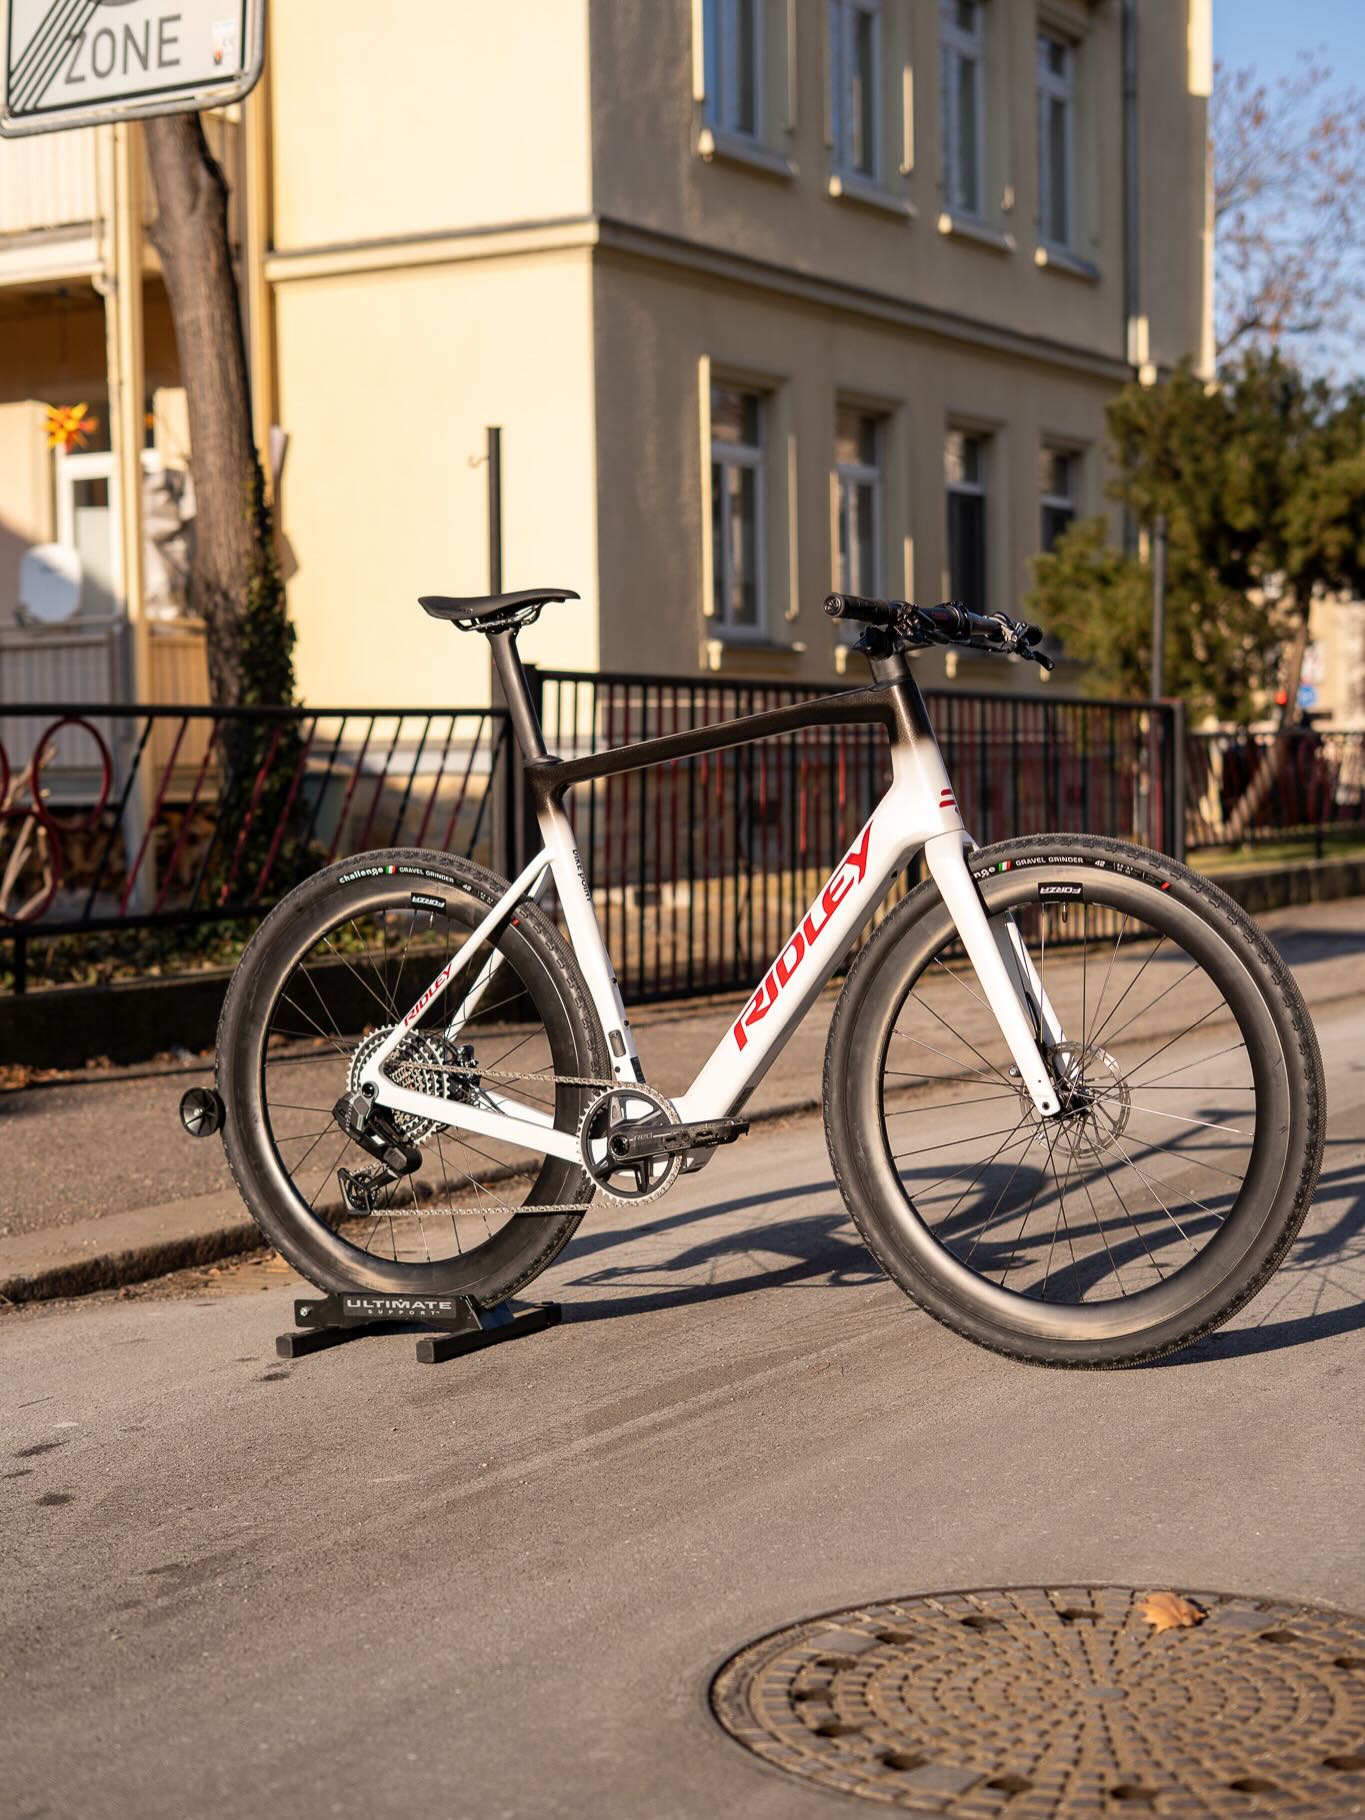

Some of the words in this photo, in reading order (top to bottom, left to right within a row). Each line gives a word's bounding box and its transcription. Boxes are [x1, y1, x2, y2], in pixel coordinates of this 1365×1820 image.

[64, 13, 182, 85] ZONE
[1015, 856, 1046, 867] GRAVEL
[1048, 856, 1084, 865] GRINDER
[338, 866, 385, 885] challenge
[399, 866, 425, 876] GRAVEL
[425, 869, 455, 884] GRINDER
[1039, 886, 1082, 895] FORZA
[411, 896, 446, 908] FORZA
[733, 819, 874, 1052] RIDLEY
[403, 960, 453, 1028] RIDLEY
[346, 1298, 452, 1310] ULTIMATE
